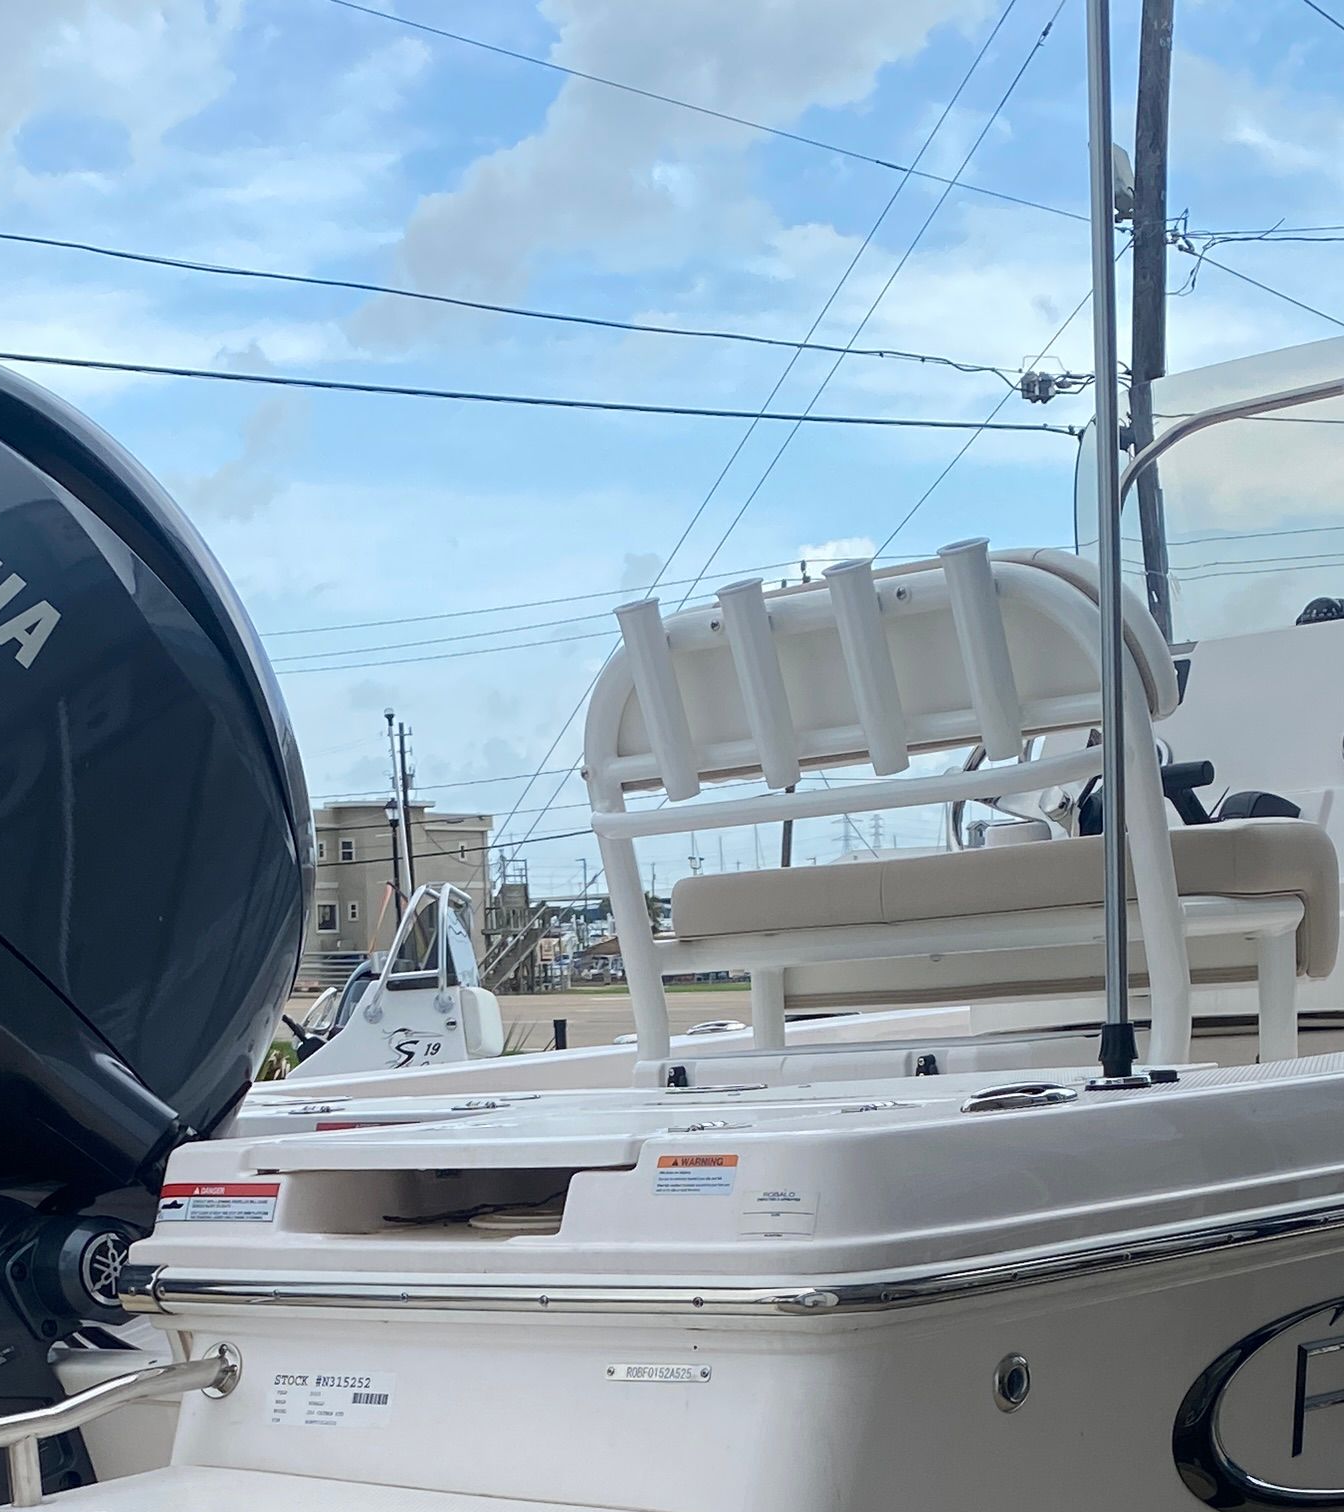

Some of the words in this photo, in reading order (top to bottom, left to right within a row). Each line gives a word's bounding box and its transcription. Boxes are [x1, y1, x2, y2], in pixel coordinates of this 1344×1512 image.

[423, 1042, 442, 1057] 19
[680, 1157, 724, 1167] WARNING
[200, 1186, 226, 1196] DANGER
[274, 1374, 309, 1386] STOCK
[315, 1375, 372, 1389] #N315252
